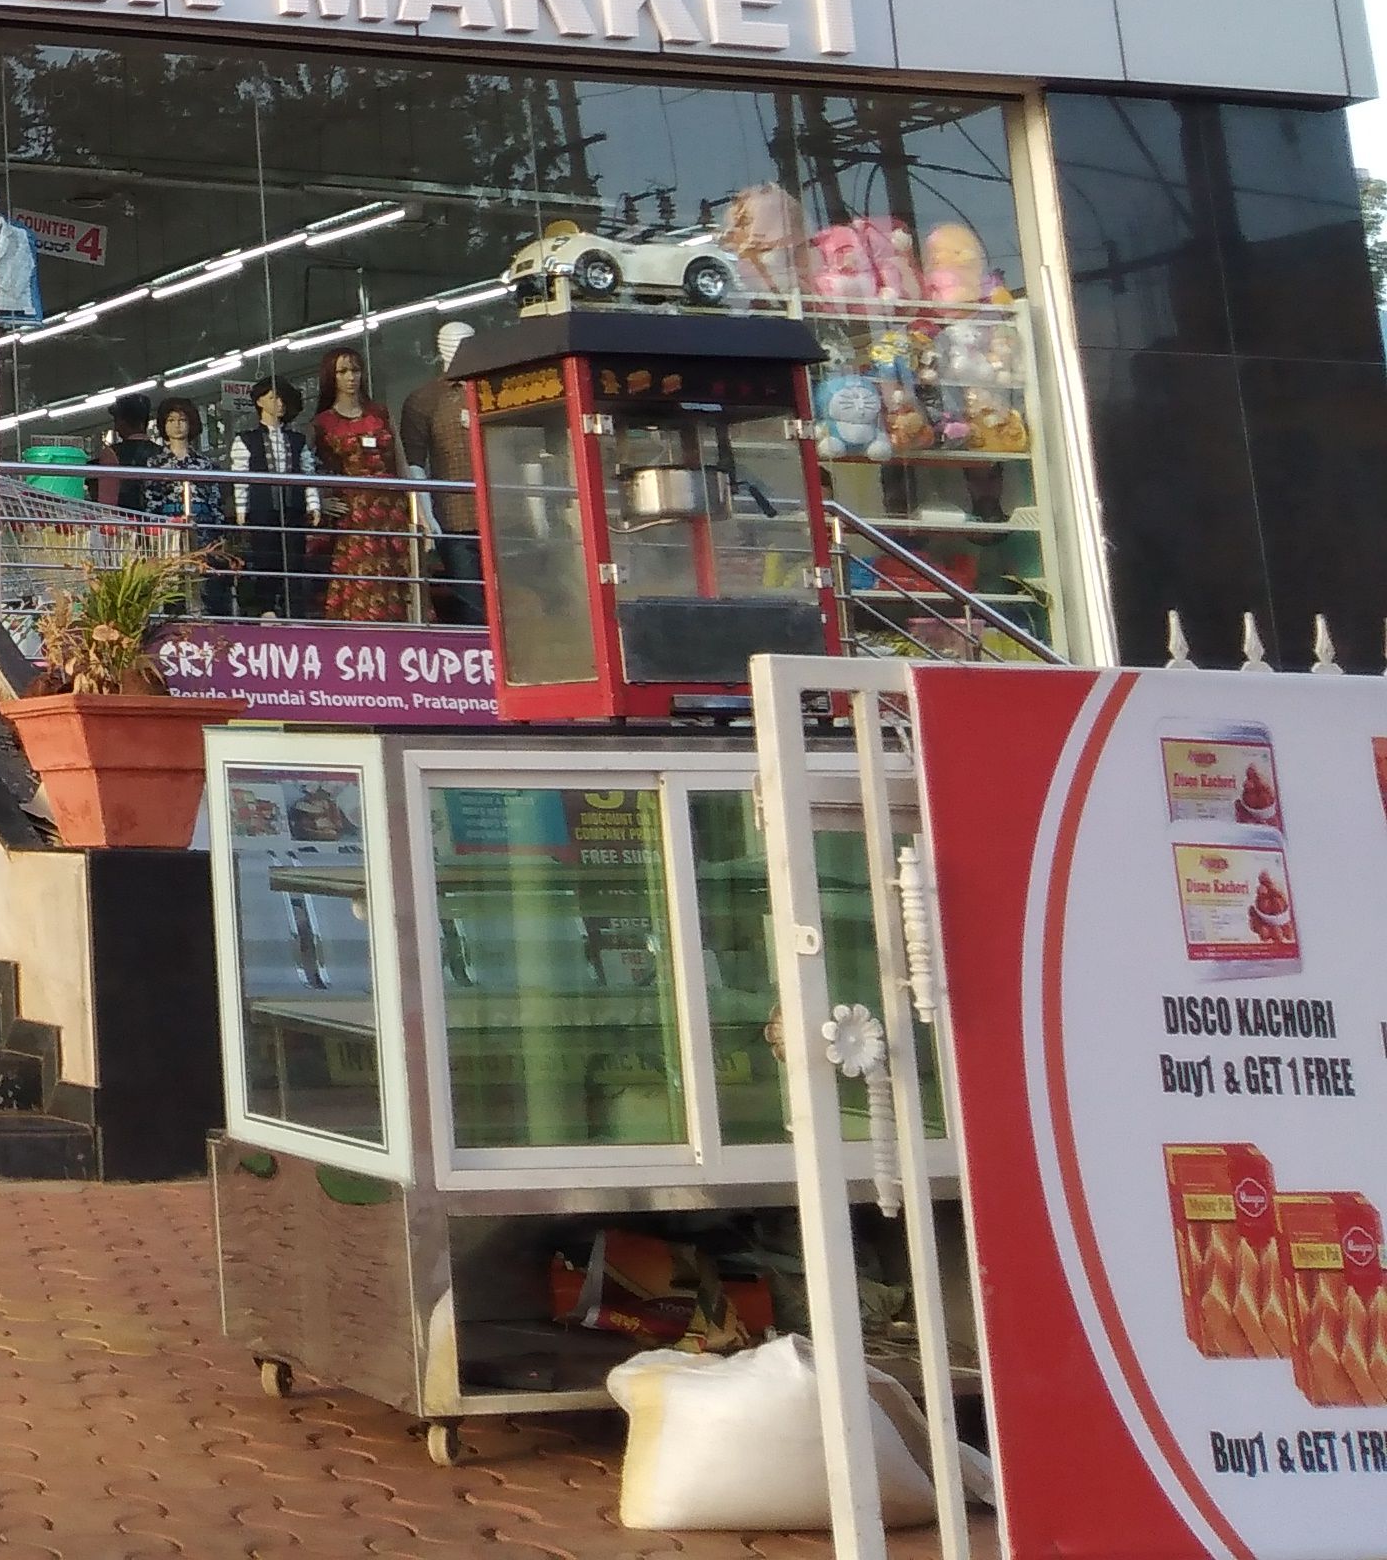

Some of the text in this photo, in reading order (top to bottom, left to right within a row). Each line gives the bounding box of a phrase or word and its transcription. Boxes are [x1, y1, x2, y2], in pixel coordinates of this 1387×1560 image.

[75, 227, 103, 261] 4
[159, 641, 213, 678] SRI
[228, 642, 322, 681] SHIVA
[335, 646, 386, 683] SAI
[309, 690, 409, 710] Showroom,
[1162, 995, 1338, 1040] DISCO KACHORI
[1223, 1060, 1243, 1095] &
[1244, 1055, 1284, 1096] GET
[1286, 1056, 1302, 1096] 1
[1302, 1056, 1357, 1097] FREE
[1276, 1436, 1298, 1473] &
[1296, 1430, 1339, 1473] GET
[1341, 1431, 1357, 1473] 1
